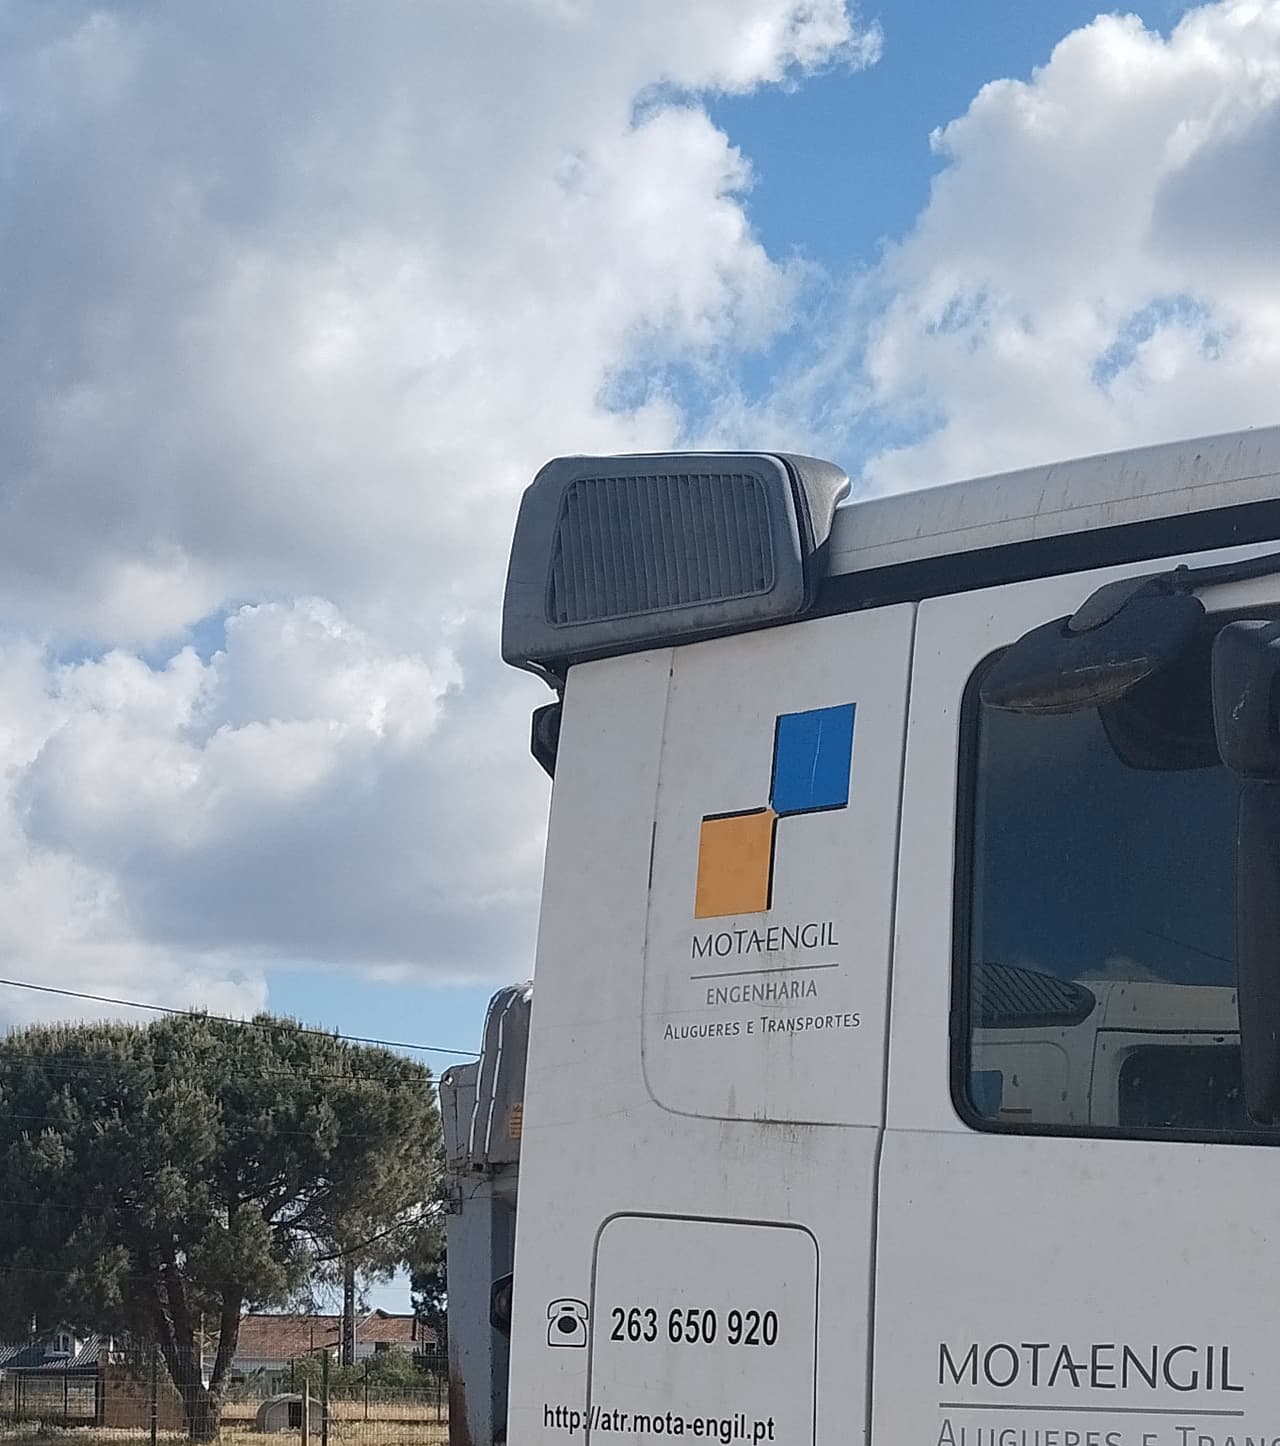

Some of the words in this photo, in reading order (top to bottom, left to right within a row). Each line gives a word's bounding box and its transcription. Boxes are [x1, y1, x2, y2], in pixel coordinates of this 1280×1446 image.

[705, 980, 818, 1005] ENGENHARIA
[663, 1020, 741, 1041] ALUGUERES
[746, 1019, 754, 1034] E
[760, 1012, 861, 1035] TRANSPORTES
[610, 1308, 658, 1342] 263
[668, 1309, 717, 1344] 650
[727, 1310, 778, 1345] 920
[543, 1404, 775, 1446] http://atr.mota-engil.pt
